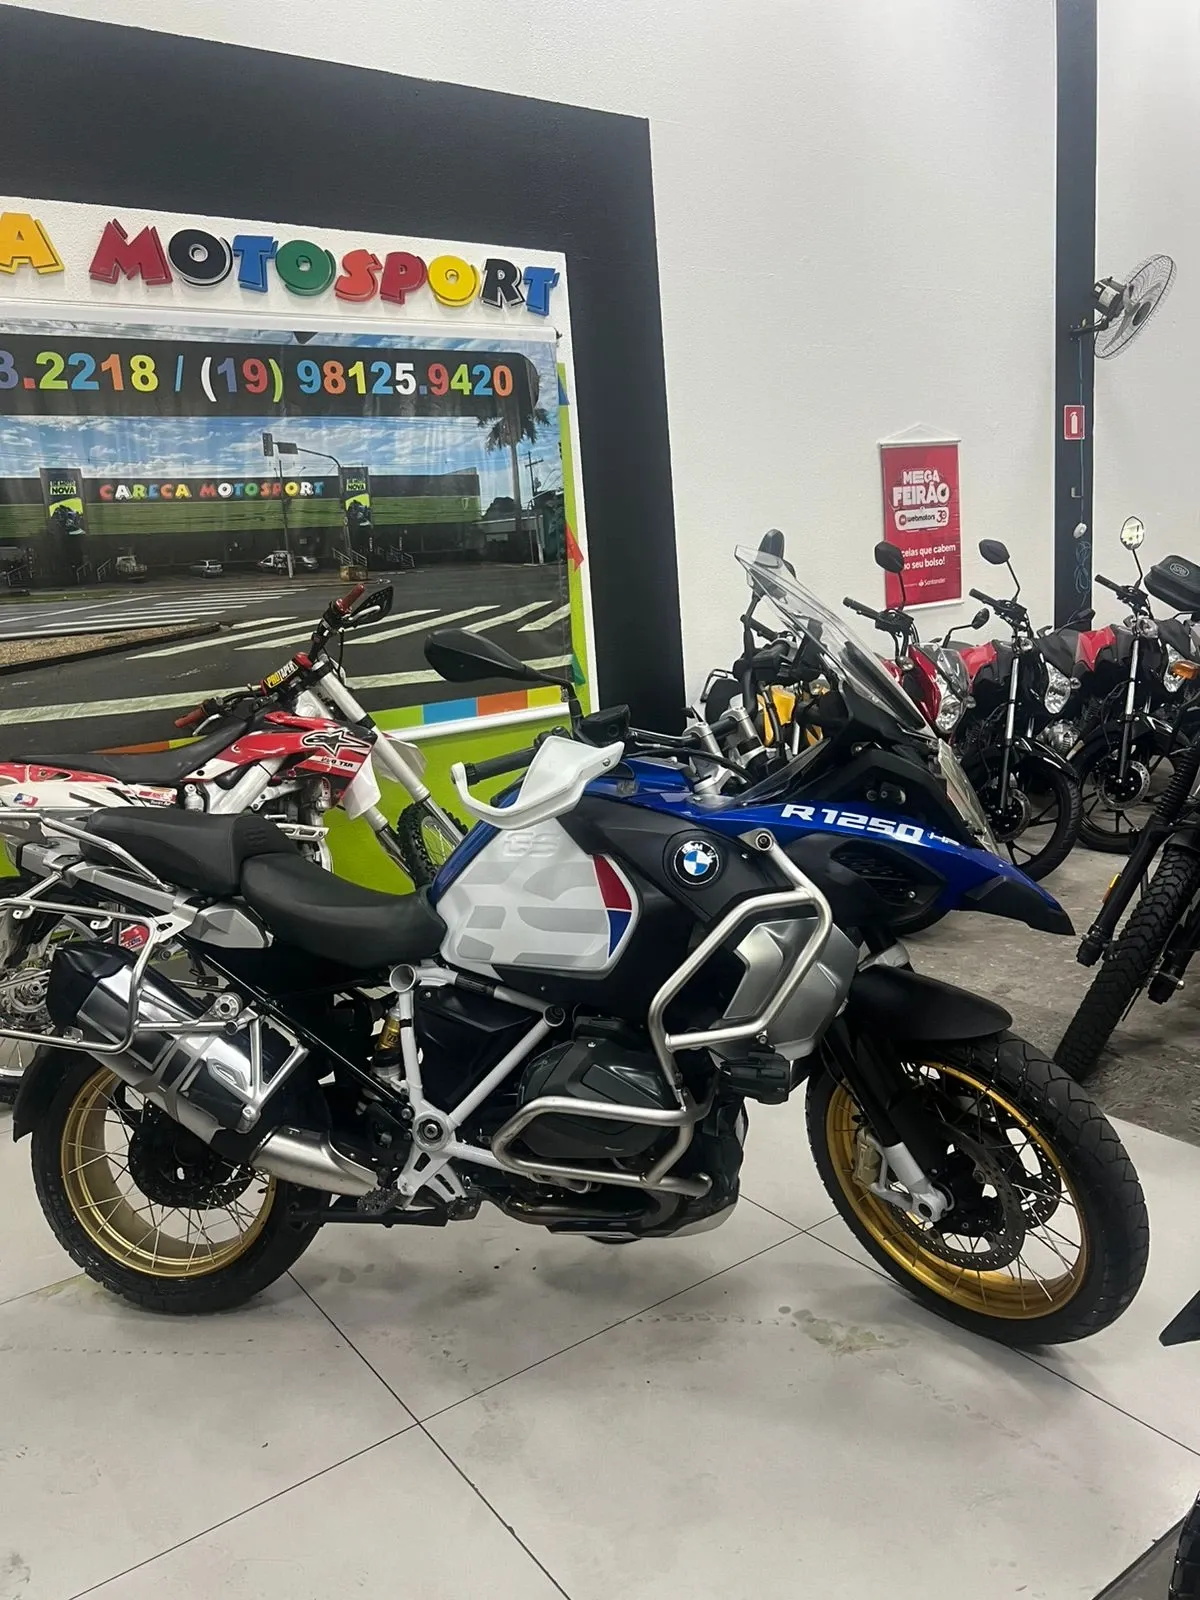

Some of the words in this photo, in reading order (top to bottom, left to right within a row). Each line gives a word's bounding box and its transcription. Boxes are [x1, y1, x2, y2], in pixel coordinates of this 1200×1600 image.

[89, 217, 560, 317] MOTOSPORT
[201, 356, 284, 402] (19)
[297, 359, 514, 397] 98125.9420
[903, 469, 940, 484] MEGA
[99, 483, 192, 502] CARECA
[200, 481, 325, 499] MOTOSPORT
[892, 481, 950, 507] FEIRÃO
[907, 514, 936, 523] webmotors
[901, 548, 918, 557] celas
[919, 547, 933, 557] que
[933, 544, 956, 554] cabem
[911, 560, 924, 569] seu
[924, 556, 946, 568] bolso!
[780, 803, 816, 822] R
[821, 808, 925, 843] 1250
[681, 841, 716, 864] BMW
